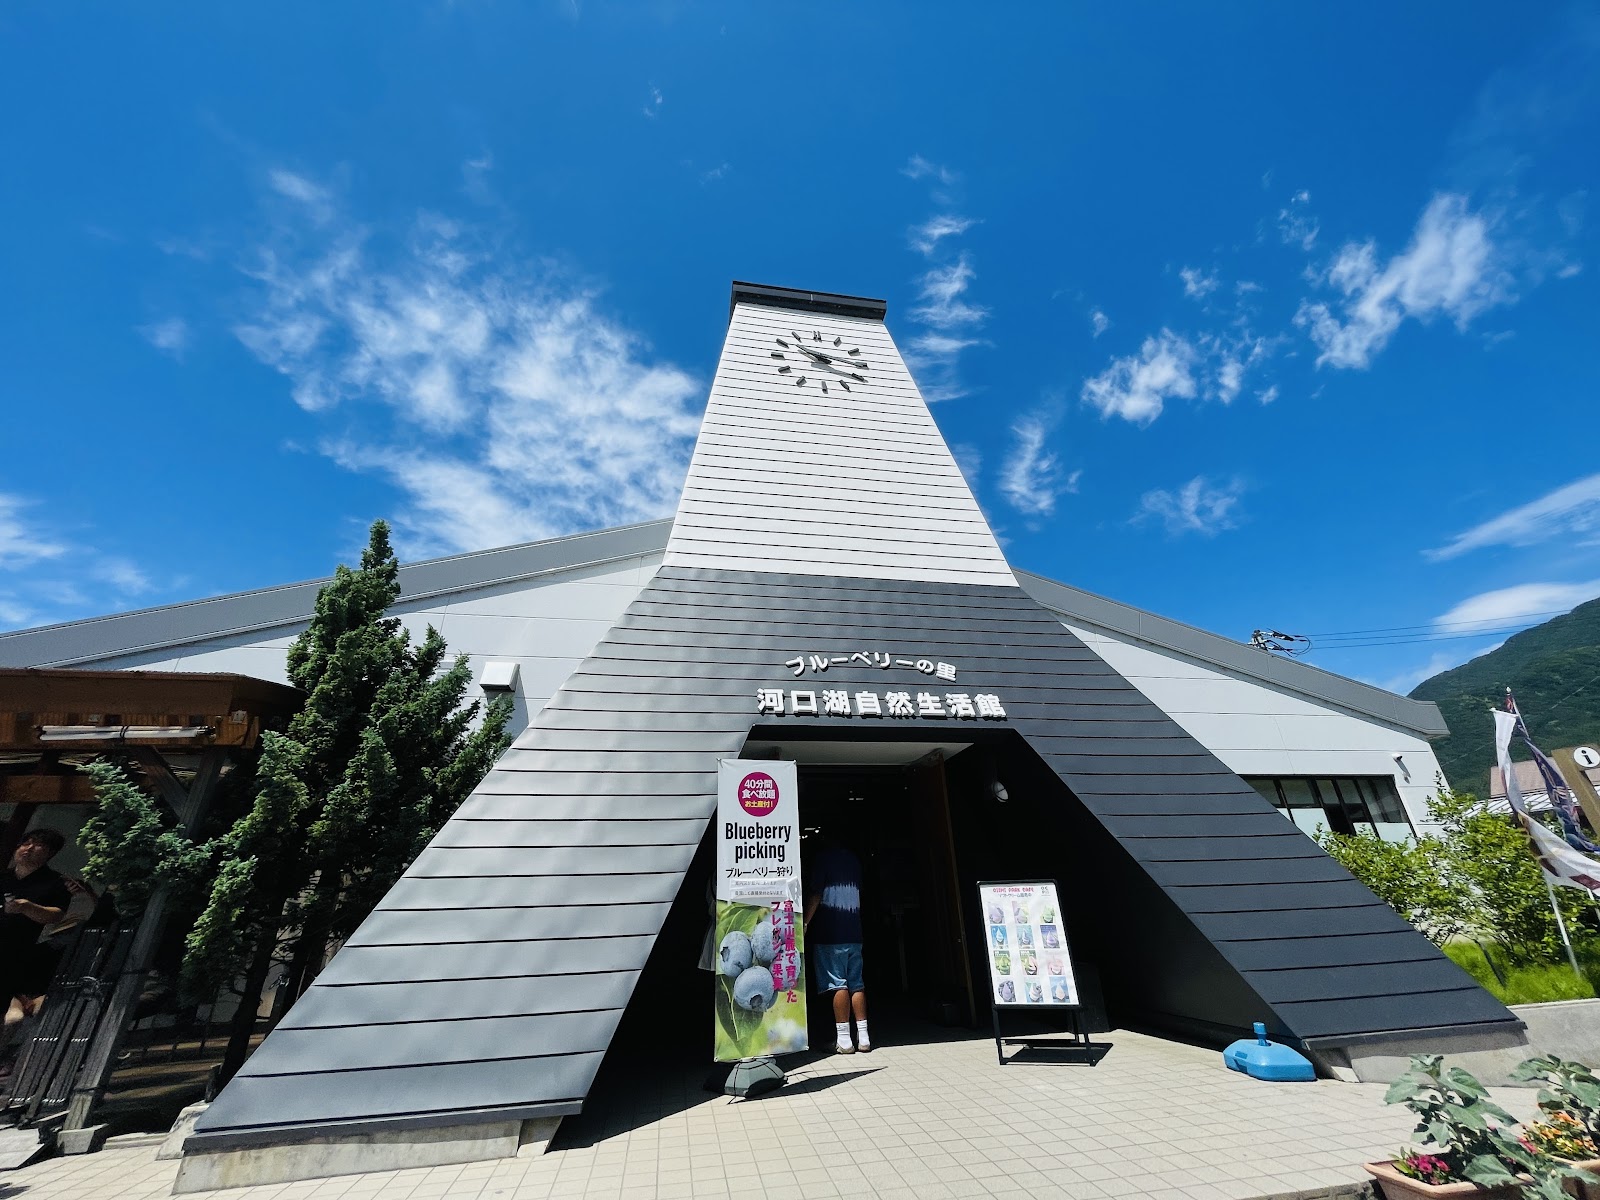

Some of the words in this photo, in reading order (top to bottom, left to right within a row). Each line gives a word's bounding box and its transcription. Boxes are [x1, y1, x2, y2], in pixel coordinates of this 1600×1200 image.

[785, 651, 957, 682] ブルーベリーの里
[757, 688, 1007, 719] 河口湖自然生活館
[742, 789, 776, 799] 食べ放題
[744, 779, 773, 789] 40分間
[725, 822, 791, 843] Blueberry
[736, 842, 785, 863] picking
[725, 866, 793, 878] ブルーベリー狩り
